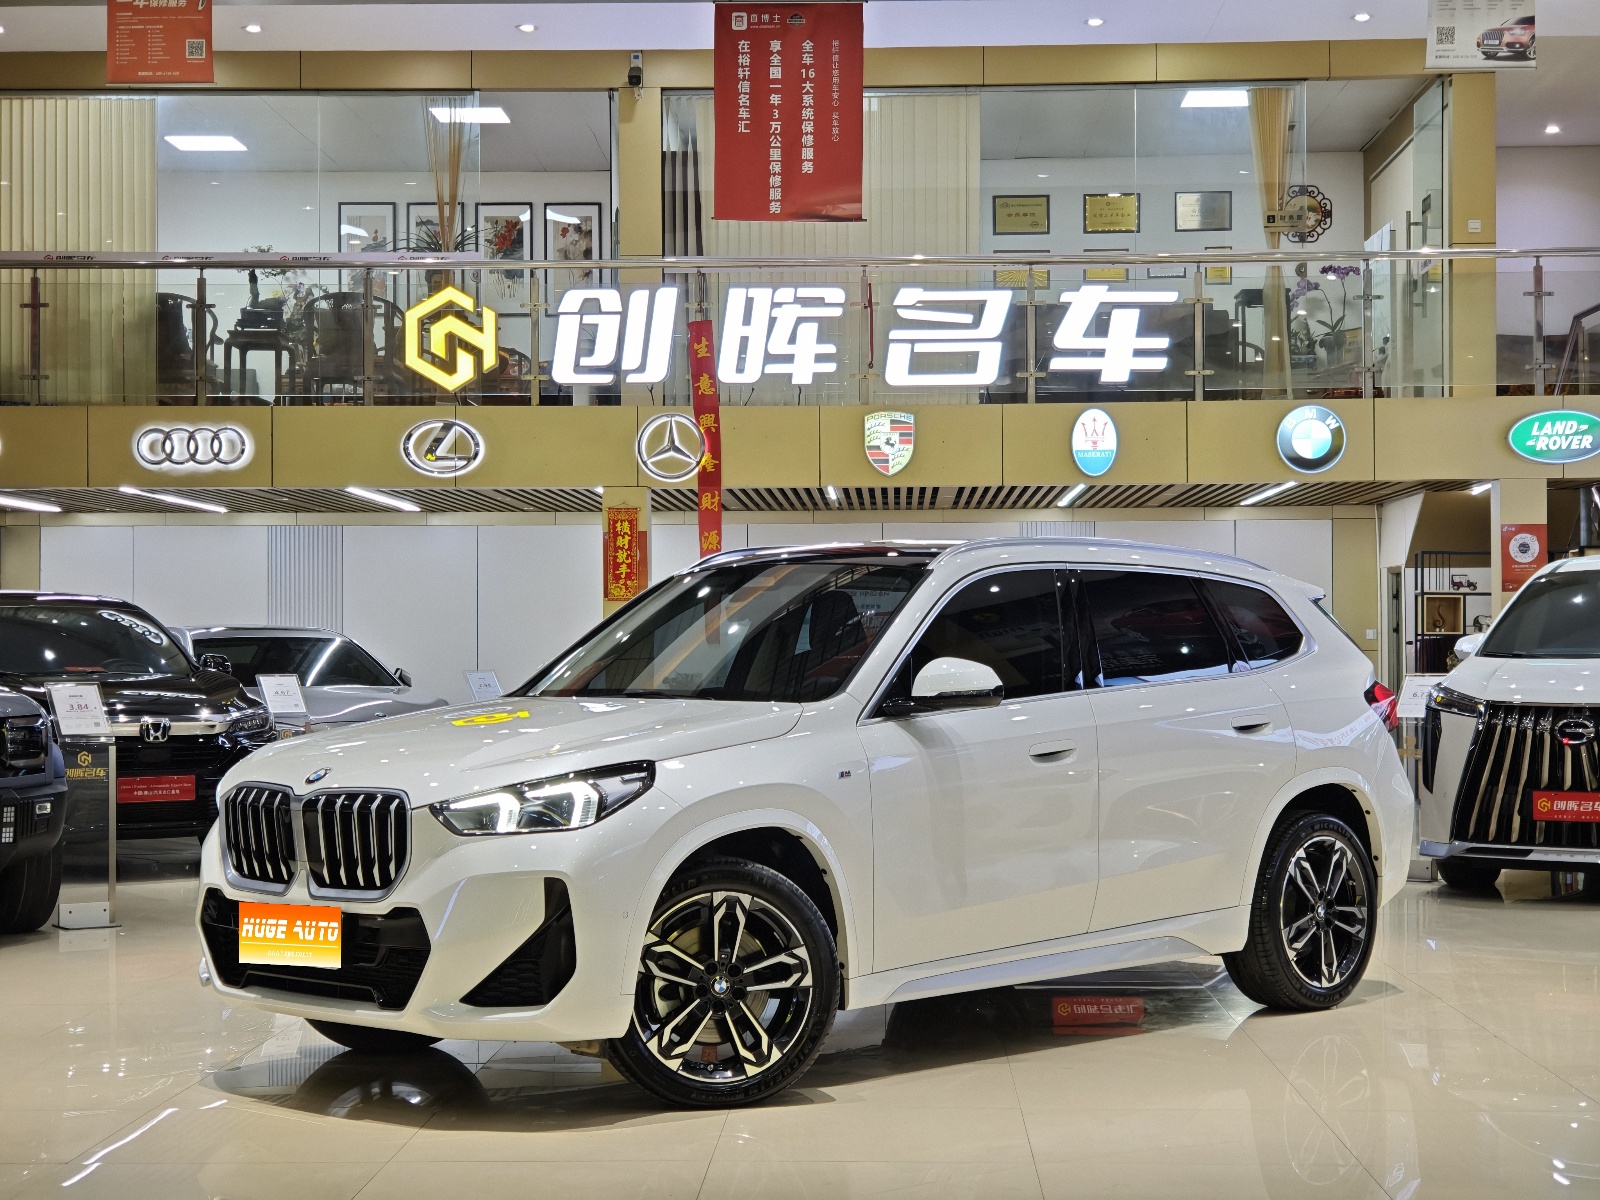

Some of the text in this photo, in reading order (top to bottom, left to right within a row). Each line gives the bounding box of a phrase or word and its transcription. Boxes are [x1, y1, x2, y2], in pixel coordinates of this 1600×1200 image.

[738, 40, 751, 133] 在裕轩信名车汇
[801, 40, 815, 174] 全车16大系统保修服务
[769, 40, 782, 214] 享全国一年3万公里保修服务
[551, 285, 1179, 386] 创晖名车
[866, 413, 913, 422] PORSCHE
[1283, 408, 1340, 430] BMW
[1531, 420, 1578, 436] LAND
[1536, 435, 1593, 451] ROVER
